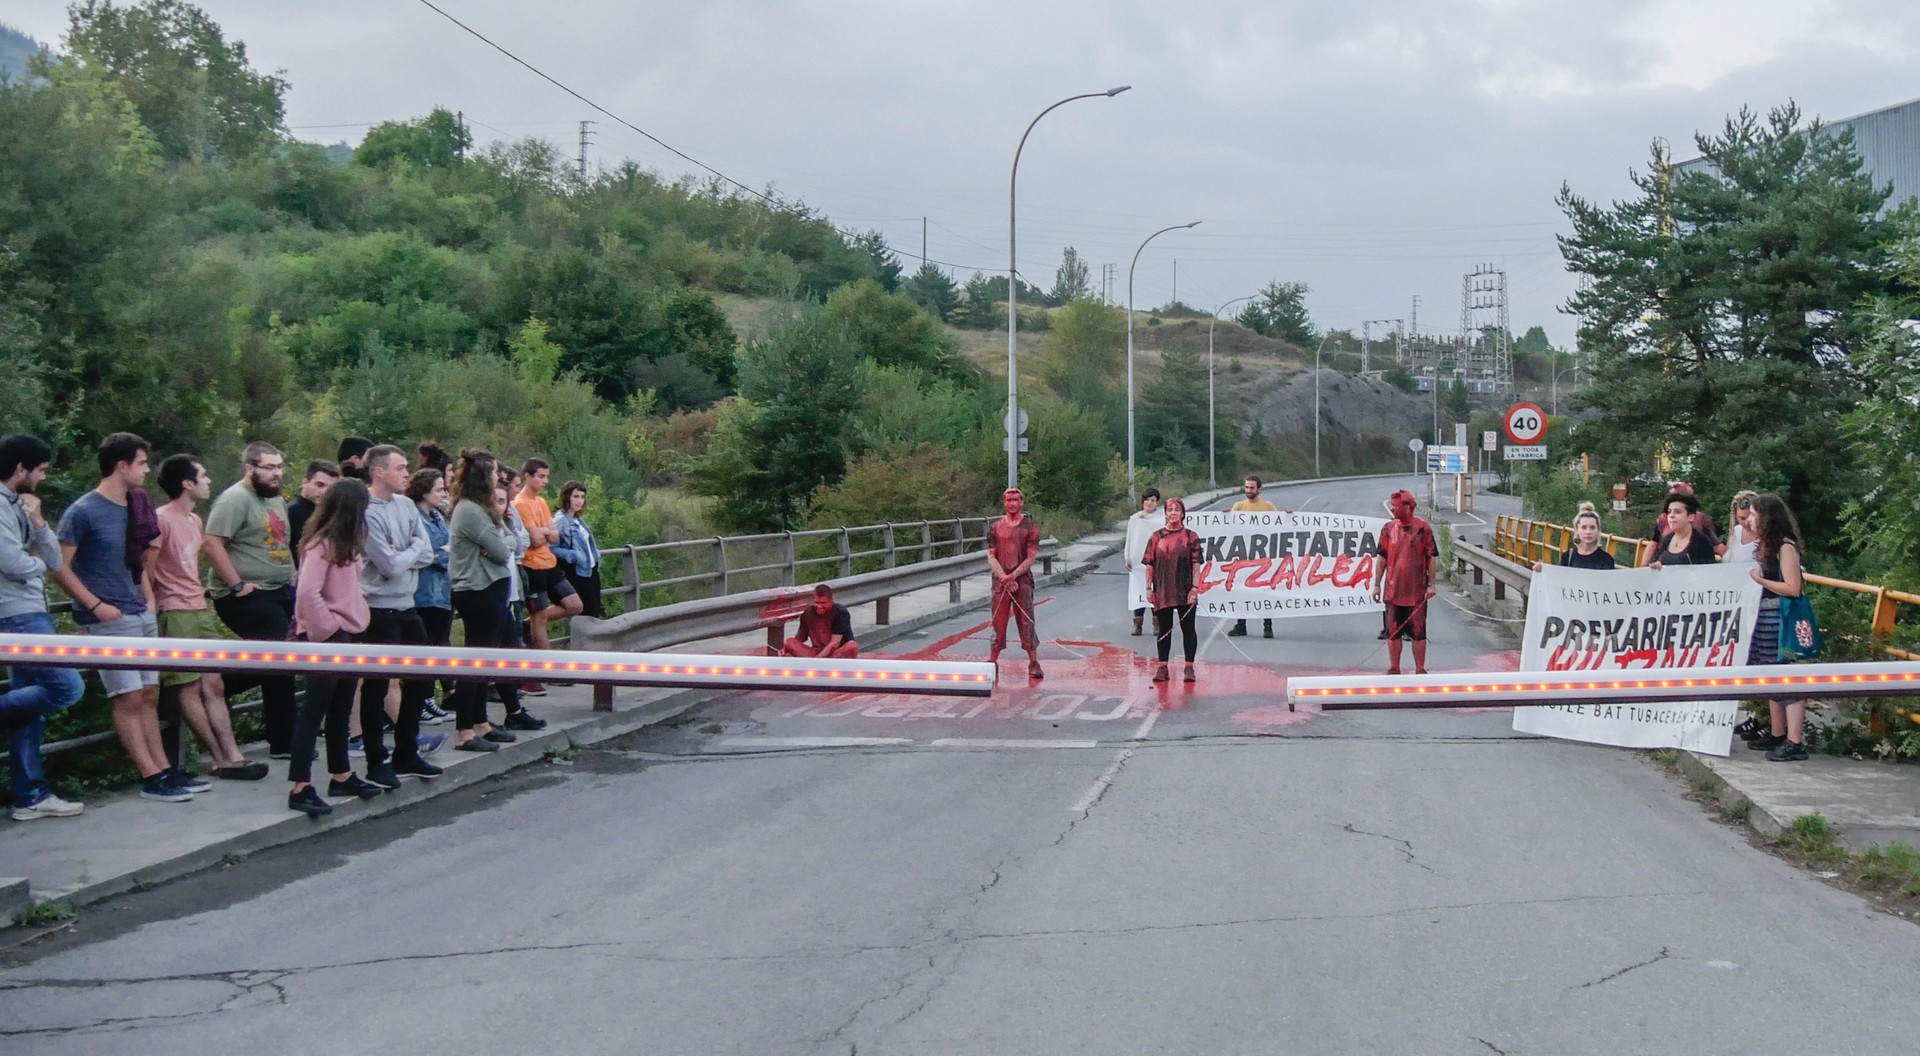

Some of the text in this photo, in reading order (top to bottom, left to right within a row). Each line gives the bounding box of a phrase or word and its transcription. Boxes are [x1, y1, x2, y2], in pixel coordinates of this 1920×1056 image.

[1513, 417, 1538, 430] 40
[1186, 513, 1366, 529] PITALISMOA SUNTSITU
[1198, 553, 1374, 595] LTZAILEA
[1561, 587, 1742, 605] KAPITALISMOA SUNTSITU
[1209, 601, 1236, 613] BAT
[1245, 598, 1331, 611] TUBACEXEN
[1540, 607, 1743, 653] PREKARIETATEA
[1594, 703, 1622, 719] BAT
